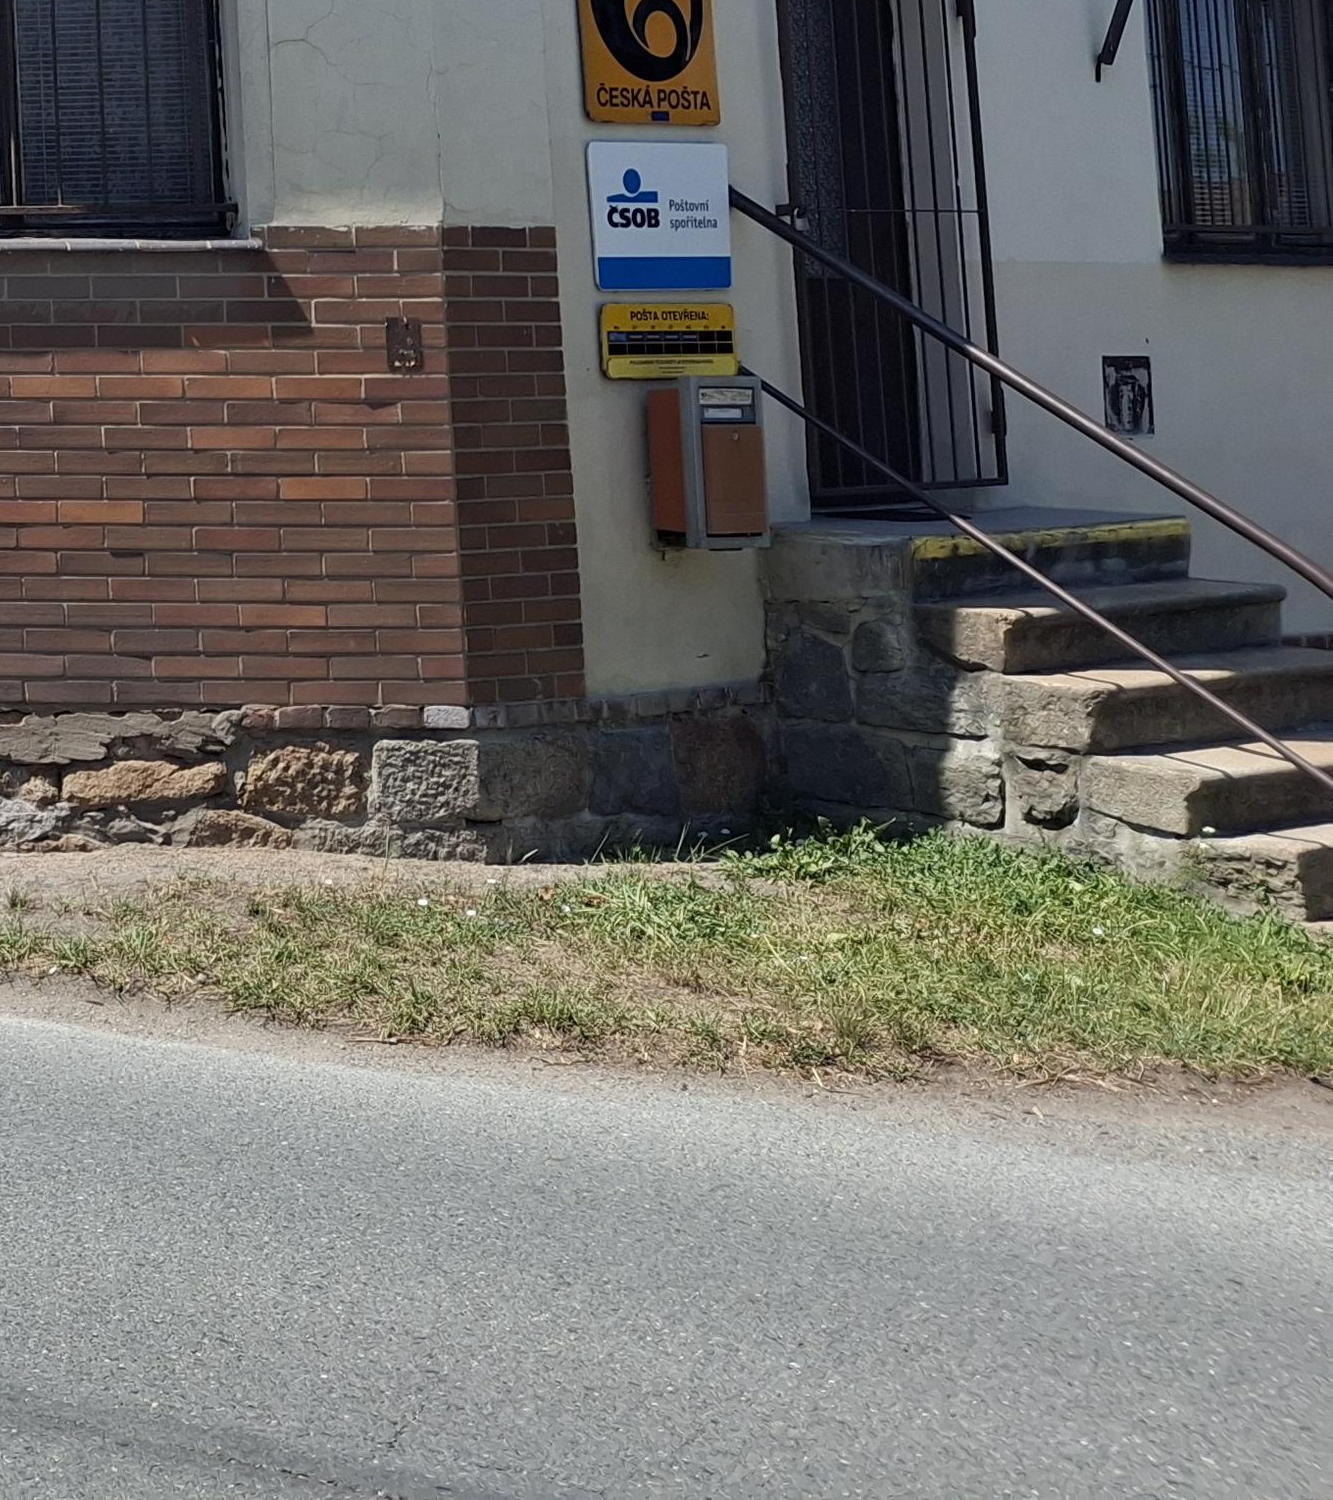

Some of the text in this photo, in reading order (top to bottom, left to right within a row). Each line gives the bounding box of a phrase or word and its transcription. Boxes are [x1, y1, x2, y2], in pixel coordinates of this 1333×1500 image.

[596, 83, 711, 111] ČESKÁ POŠTA
[669, 199, 709, 212] Poštovní
[607, 204, 660, 228] ČSOB
[670, 216, 718, 232] spořitelna
[630, 308, 659, 321] POŠTA
